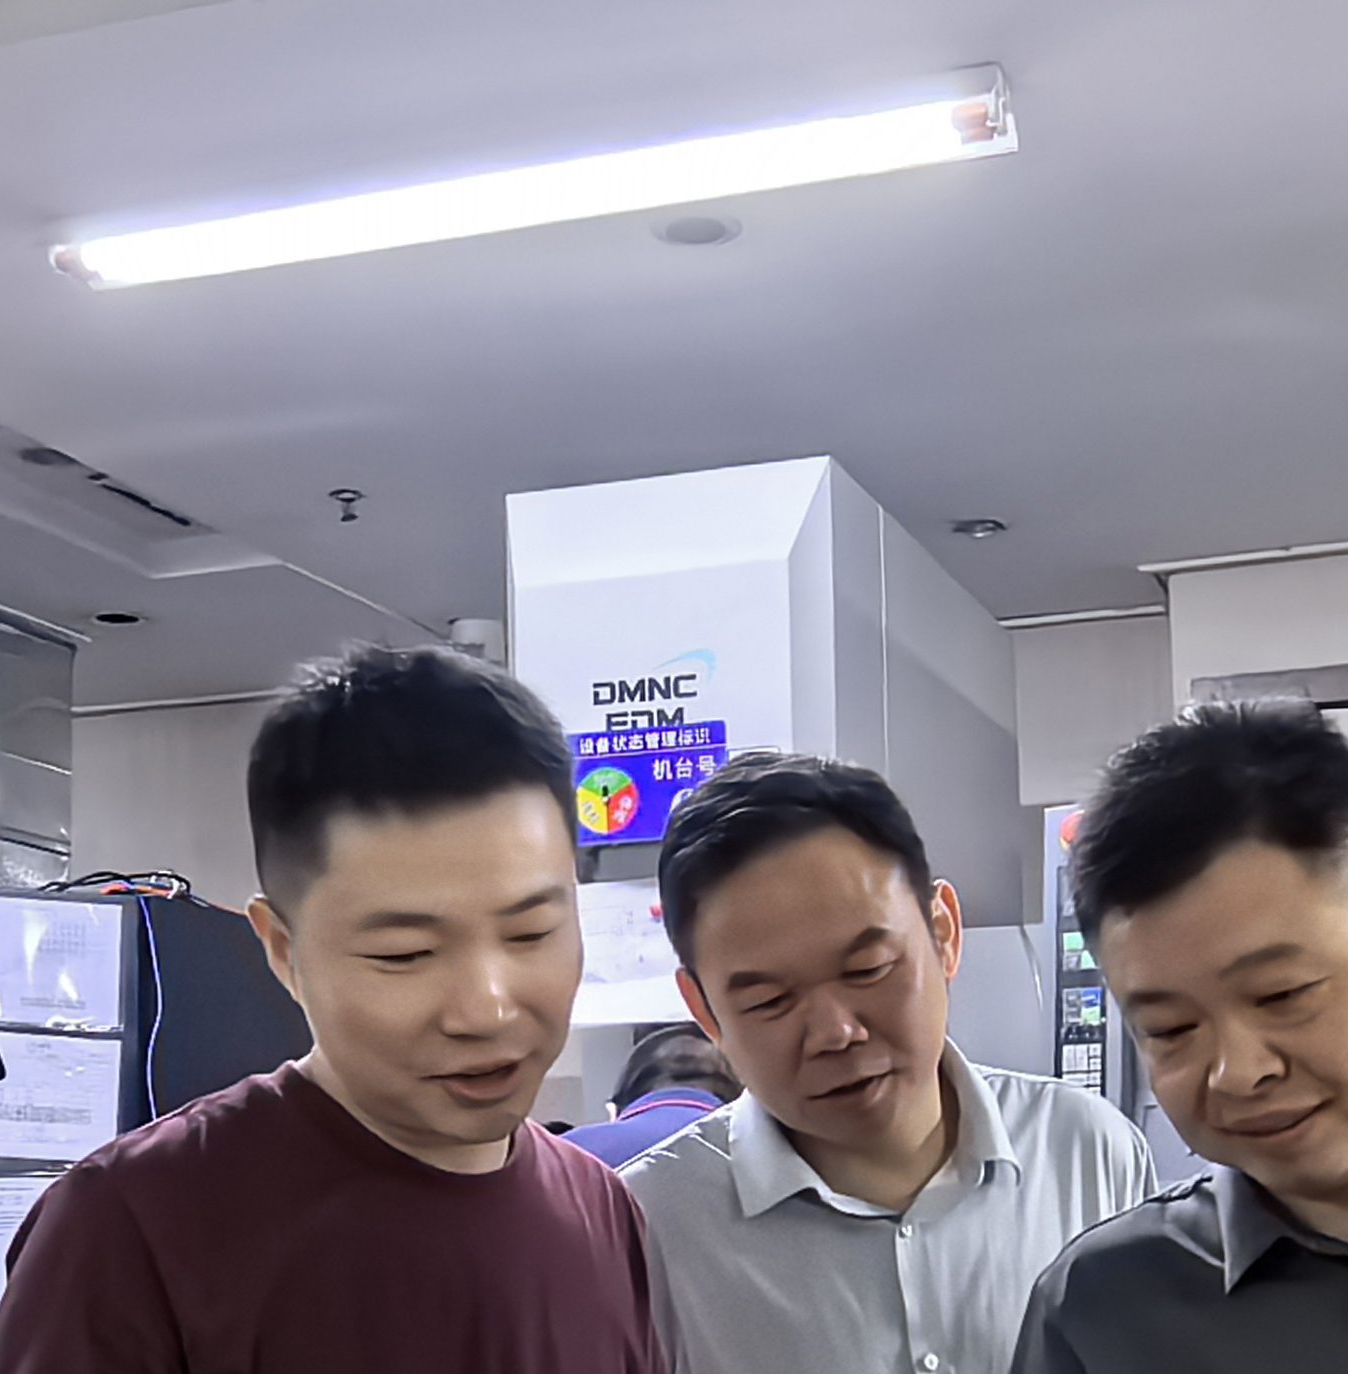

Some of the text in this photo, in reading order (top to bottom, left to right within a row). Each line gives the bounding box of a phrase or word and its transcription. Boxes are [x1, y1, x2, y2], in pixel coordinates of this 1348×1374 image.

[593, 674, 697, 706] DMNC
[652, 755, 716, 781] 机台号
